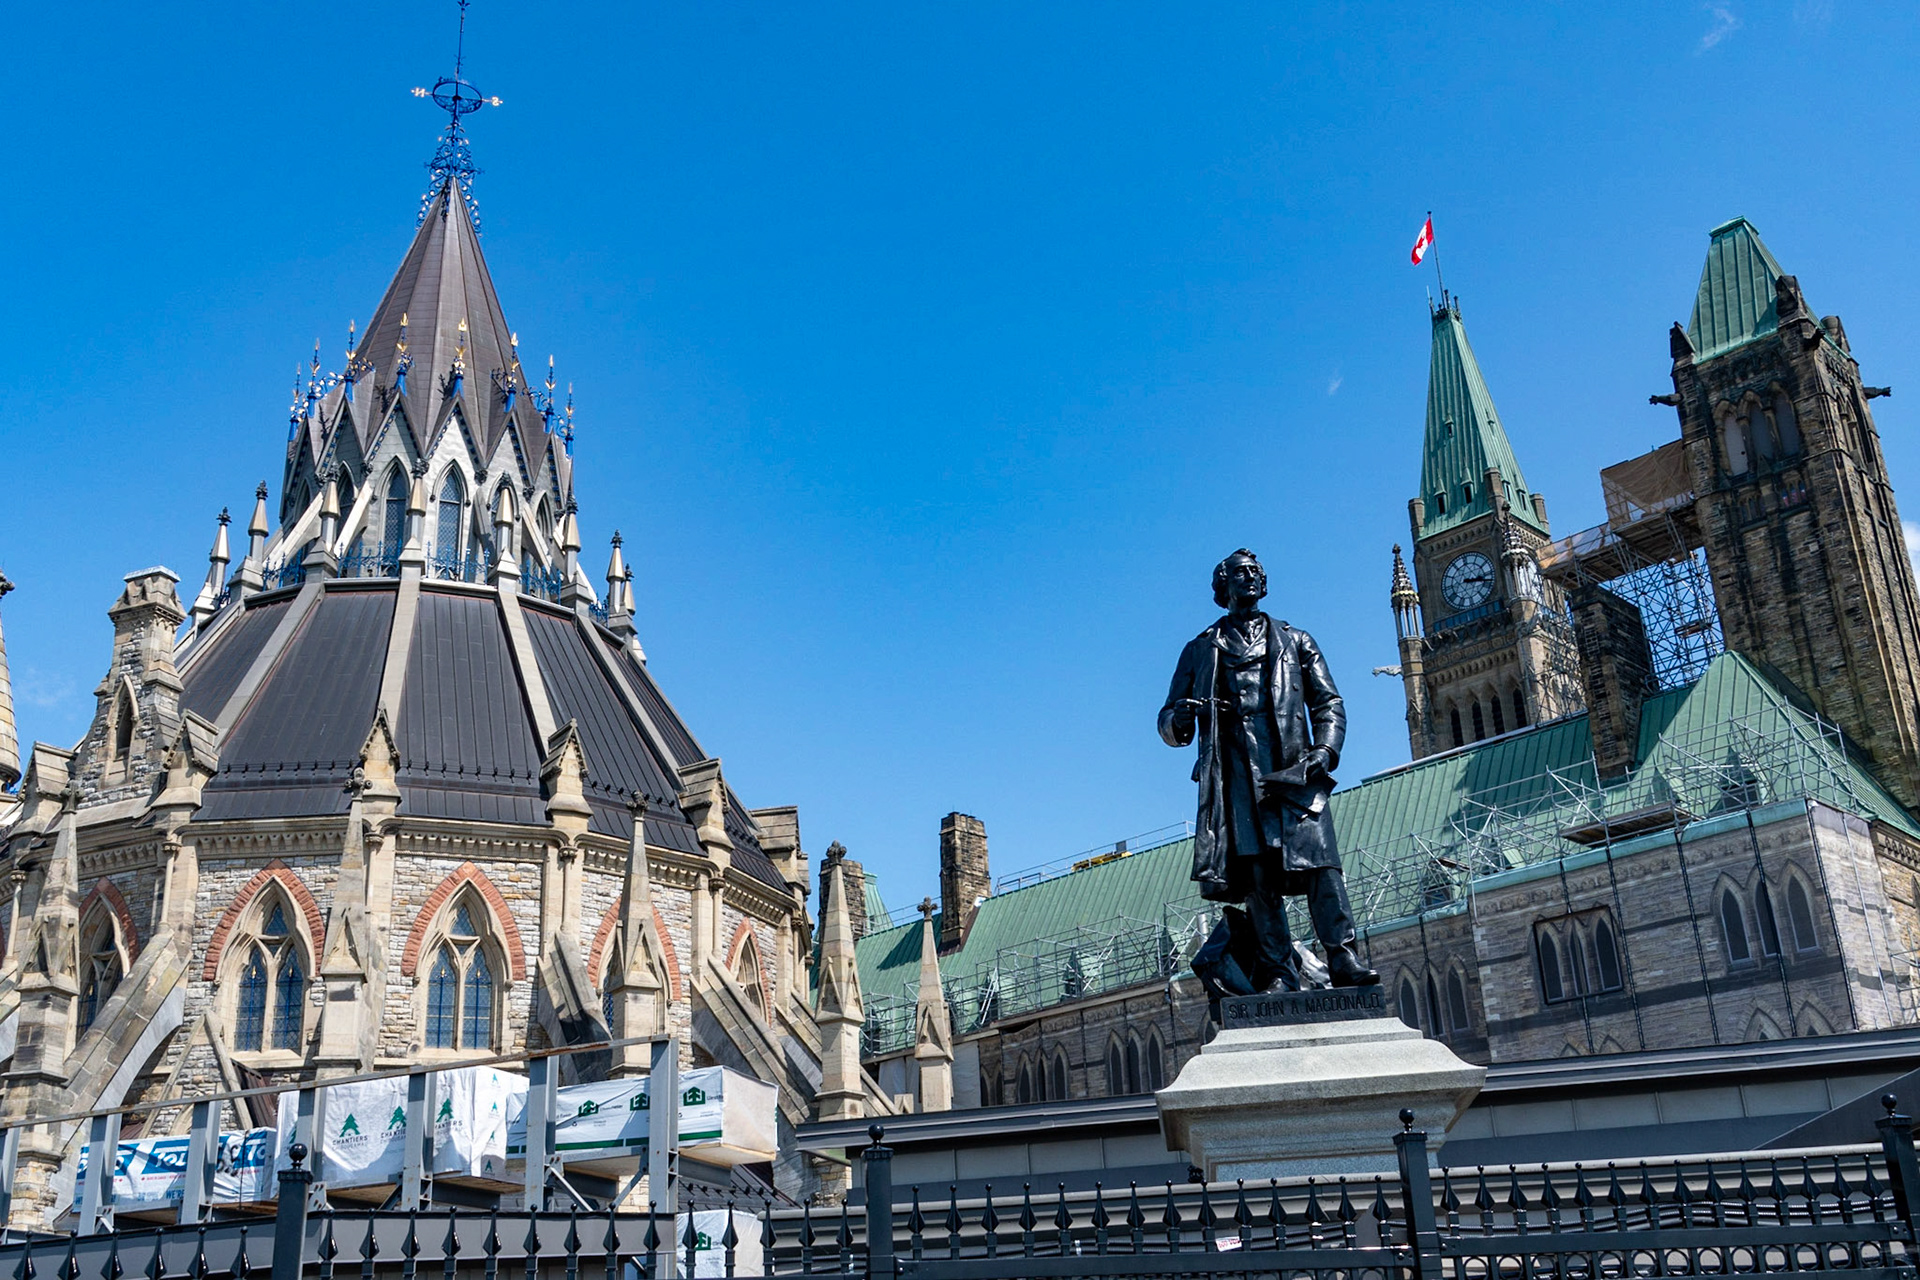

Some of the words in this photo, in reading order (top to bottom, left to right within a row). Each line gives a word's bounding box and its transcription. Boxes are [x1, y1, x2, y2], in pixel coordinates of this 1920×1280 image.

[1228, 1003, 1249, 1020] SIR
[1254, 1002, 1285, 1018] JOHN
[1291, 1002, 1300, 1015] A
[1305, 993, 1380, 1013] MACDONALD
[332, 1135, 369, 1145] CHANTIERS
[380, 1129, 406, 1139] CHANTIE
[154, 1146, 188, 1168] TOL
